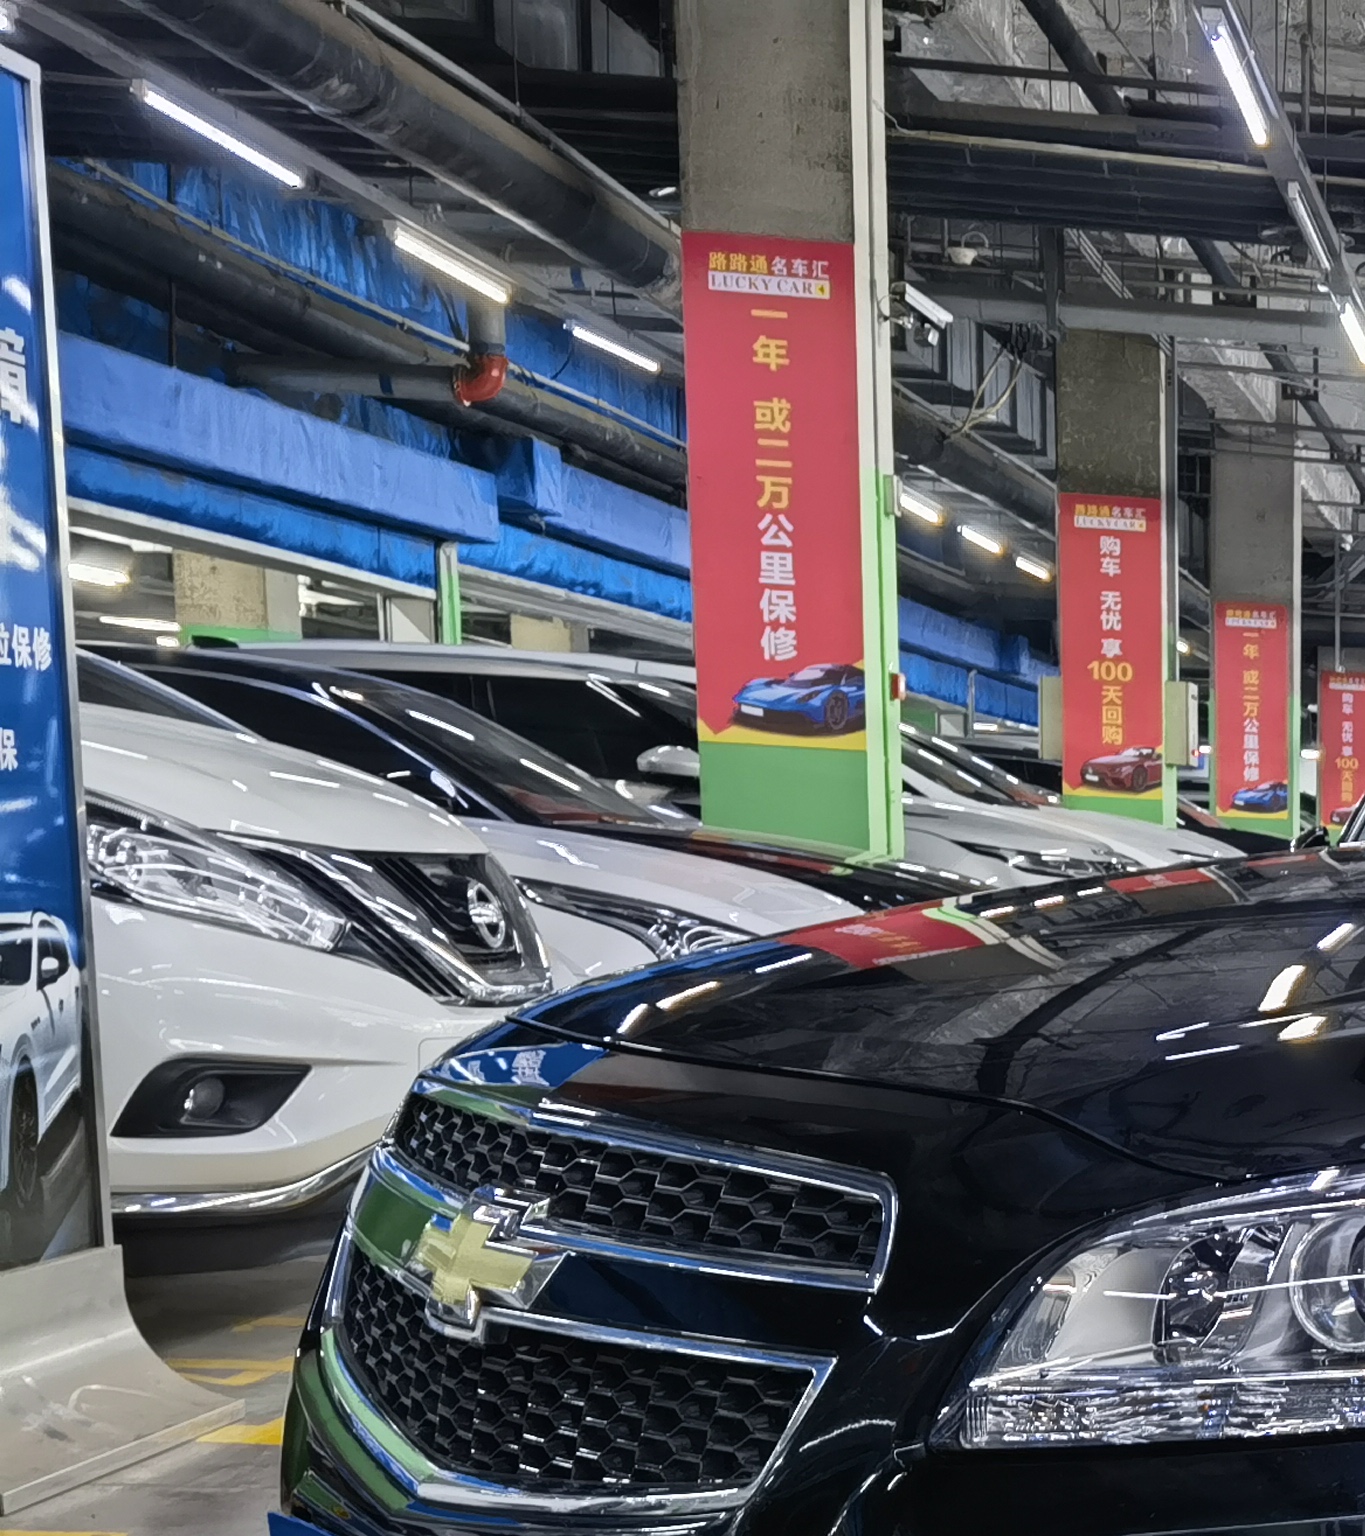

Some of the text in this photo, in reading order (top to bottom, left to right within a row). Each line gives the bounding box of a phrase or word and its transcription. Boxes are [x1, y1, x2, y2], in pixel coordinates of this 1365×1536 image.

[709, 251, 830, 279] 路路通名车汇
[711, 274, 814, 294] LUCKY CAR
[1087, 661, 1133, 682] 100
[1335, 757, 1359, 769] 100
